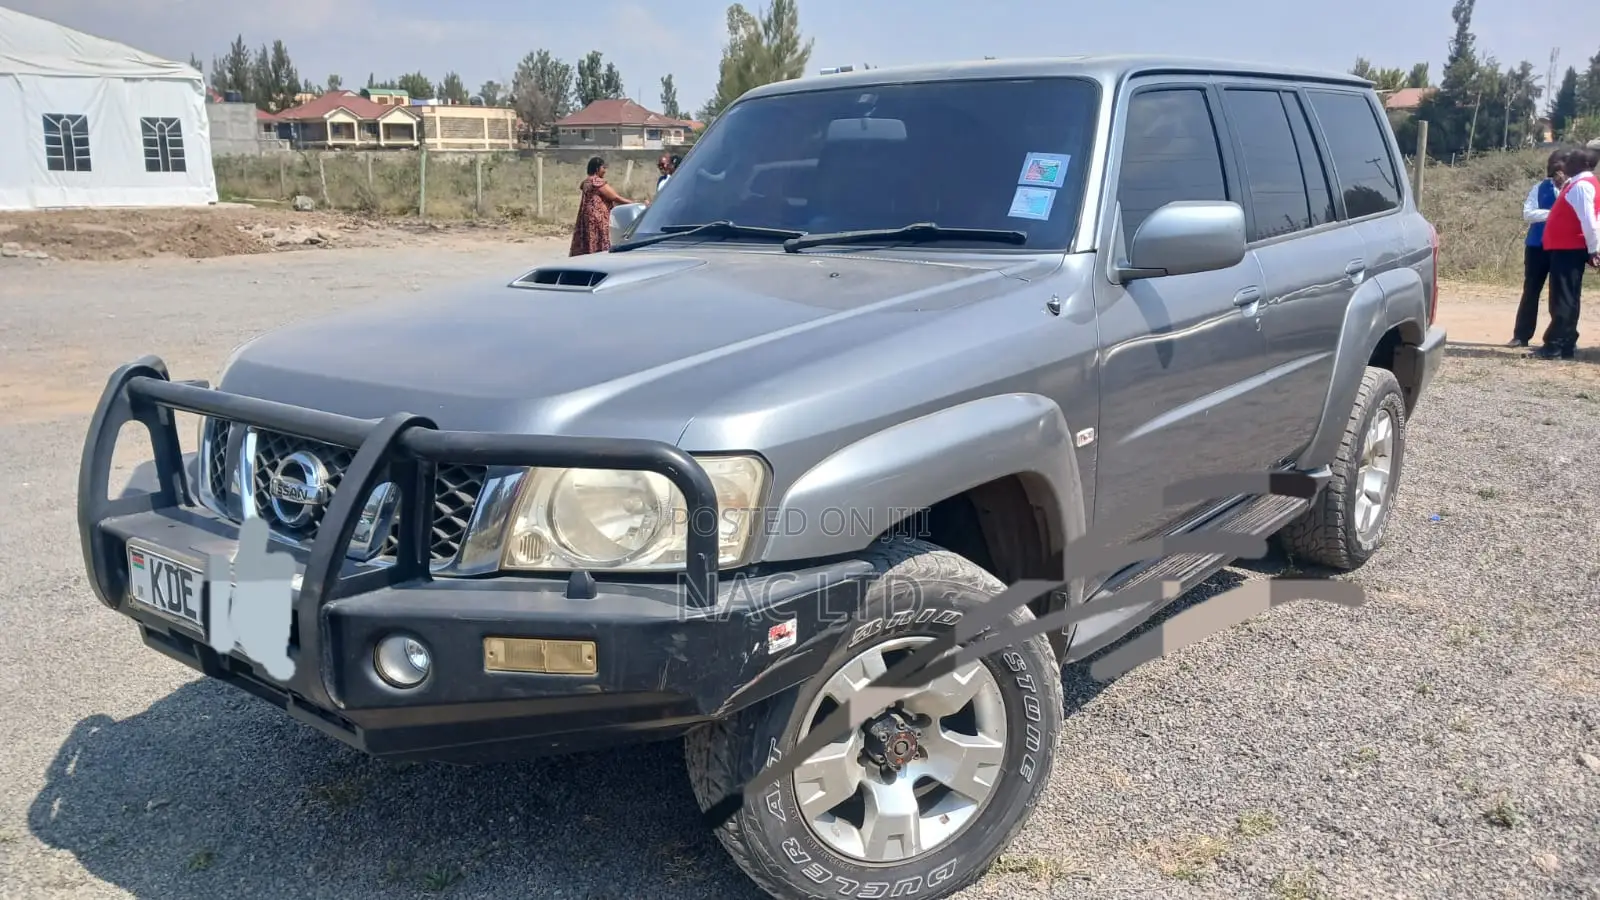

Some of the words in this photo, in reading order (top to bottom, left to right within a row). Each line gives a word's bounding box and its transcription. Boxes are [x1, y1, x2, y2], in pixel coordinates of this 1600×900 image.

[271, 479, 308, 501] SSAN
[149, 558, 197, 620] KDE
[781, 836, 958, 899] DUELER
